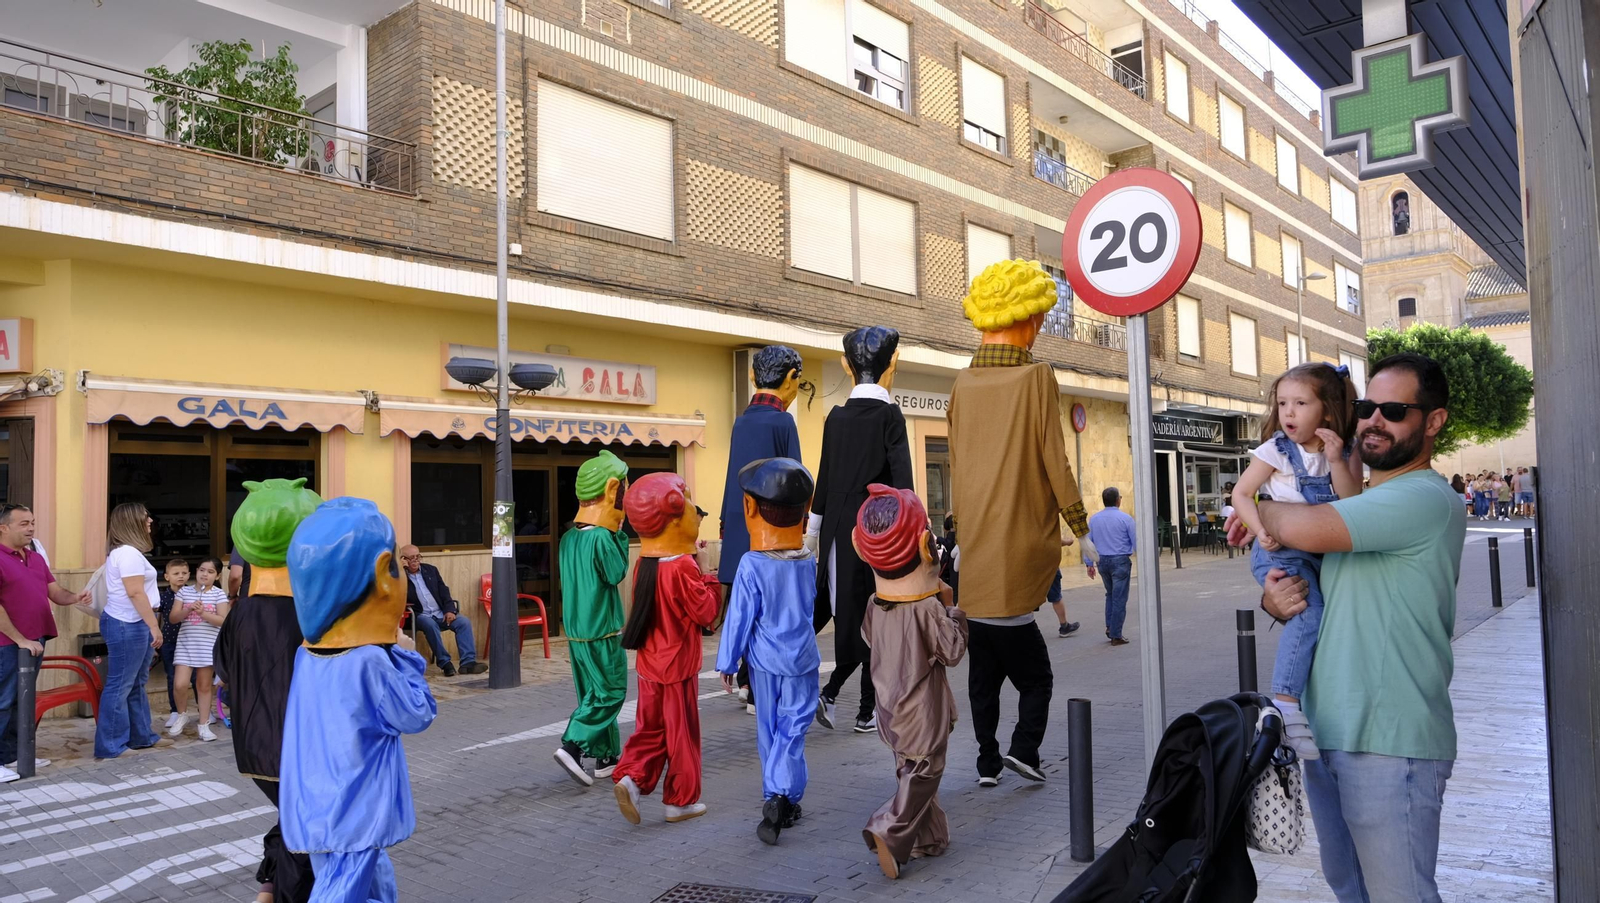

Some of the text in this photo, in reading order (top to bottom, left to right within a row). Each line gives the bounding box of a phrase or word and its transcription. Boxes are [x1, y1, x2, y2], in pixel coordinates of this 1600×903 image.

[324, 164, 333, 175] LG
[1090, 212, 1168, 273] 20
[177, 397, 288, 420] GALA
[895, 395, 949, 411] SEGUROS
[1180, 424, 1215, 439] ARGENTINA
